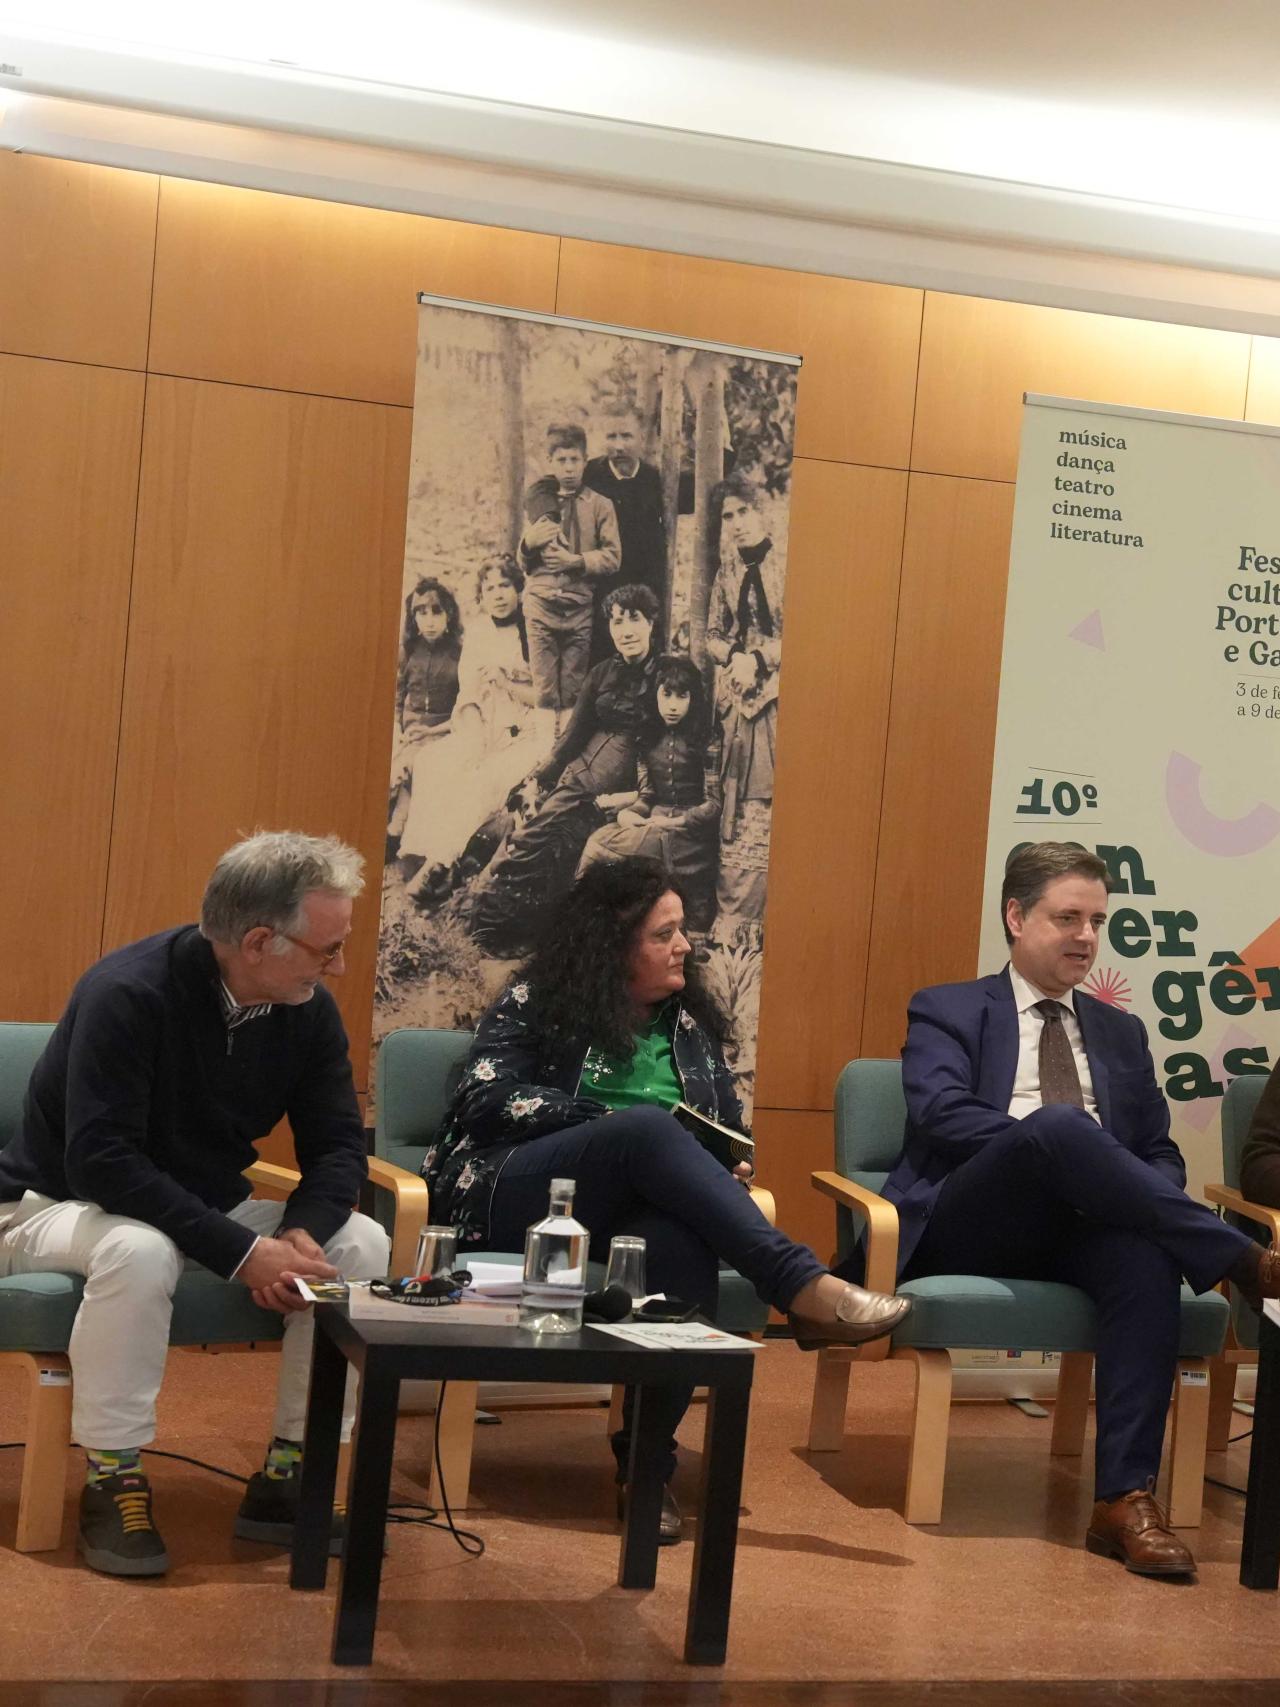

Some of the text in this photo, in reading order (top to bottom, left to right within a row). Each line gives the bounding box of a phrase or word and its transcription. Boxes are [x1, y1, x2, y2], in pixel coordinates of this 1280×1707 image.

[1059, 430, 1127, 450] música
[1057, 452, 1115, 474] dança
[1055, 476, 1114, 496] teatro
[1052, 502, 1122, 521] cinema
[1050, 523, 1144, 547] literatura
[1224, 645, 1239, 663] e
[1236, 682, 1245, 697] 3
[1251, 684, 1267, 699] de
[1237, 706, 1246, 716] a
[1251, 704, 1260, 718] 9
[1265, 705, 1280, 719] de
[1016, 778, 1098, 816] 10º
[1108, 907, 1198, 958] er
